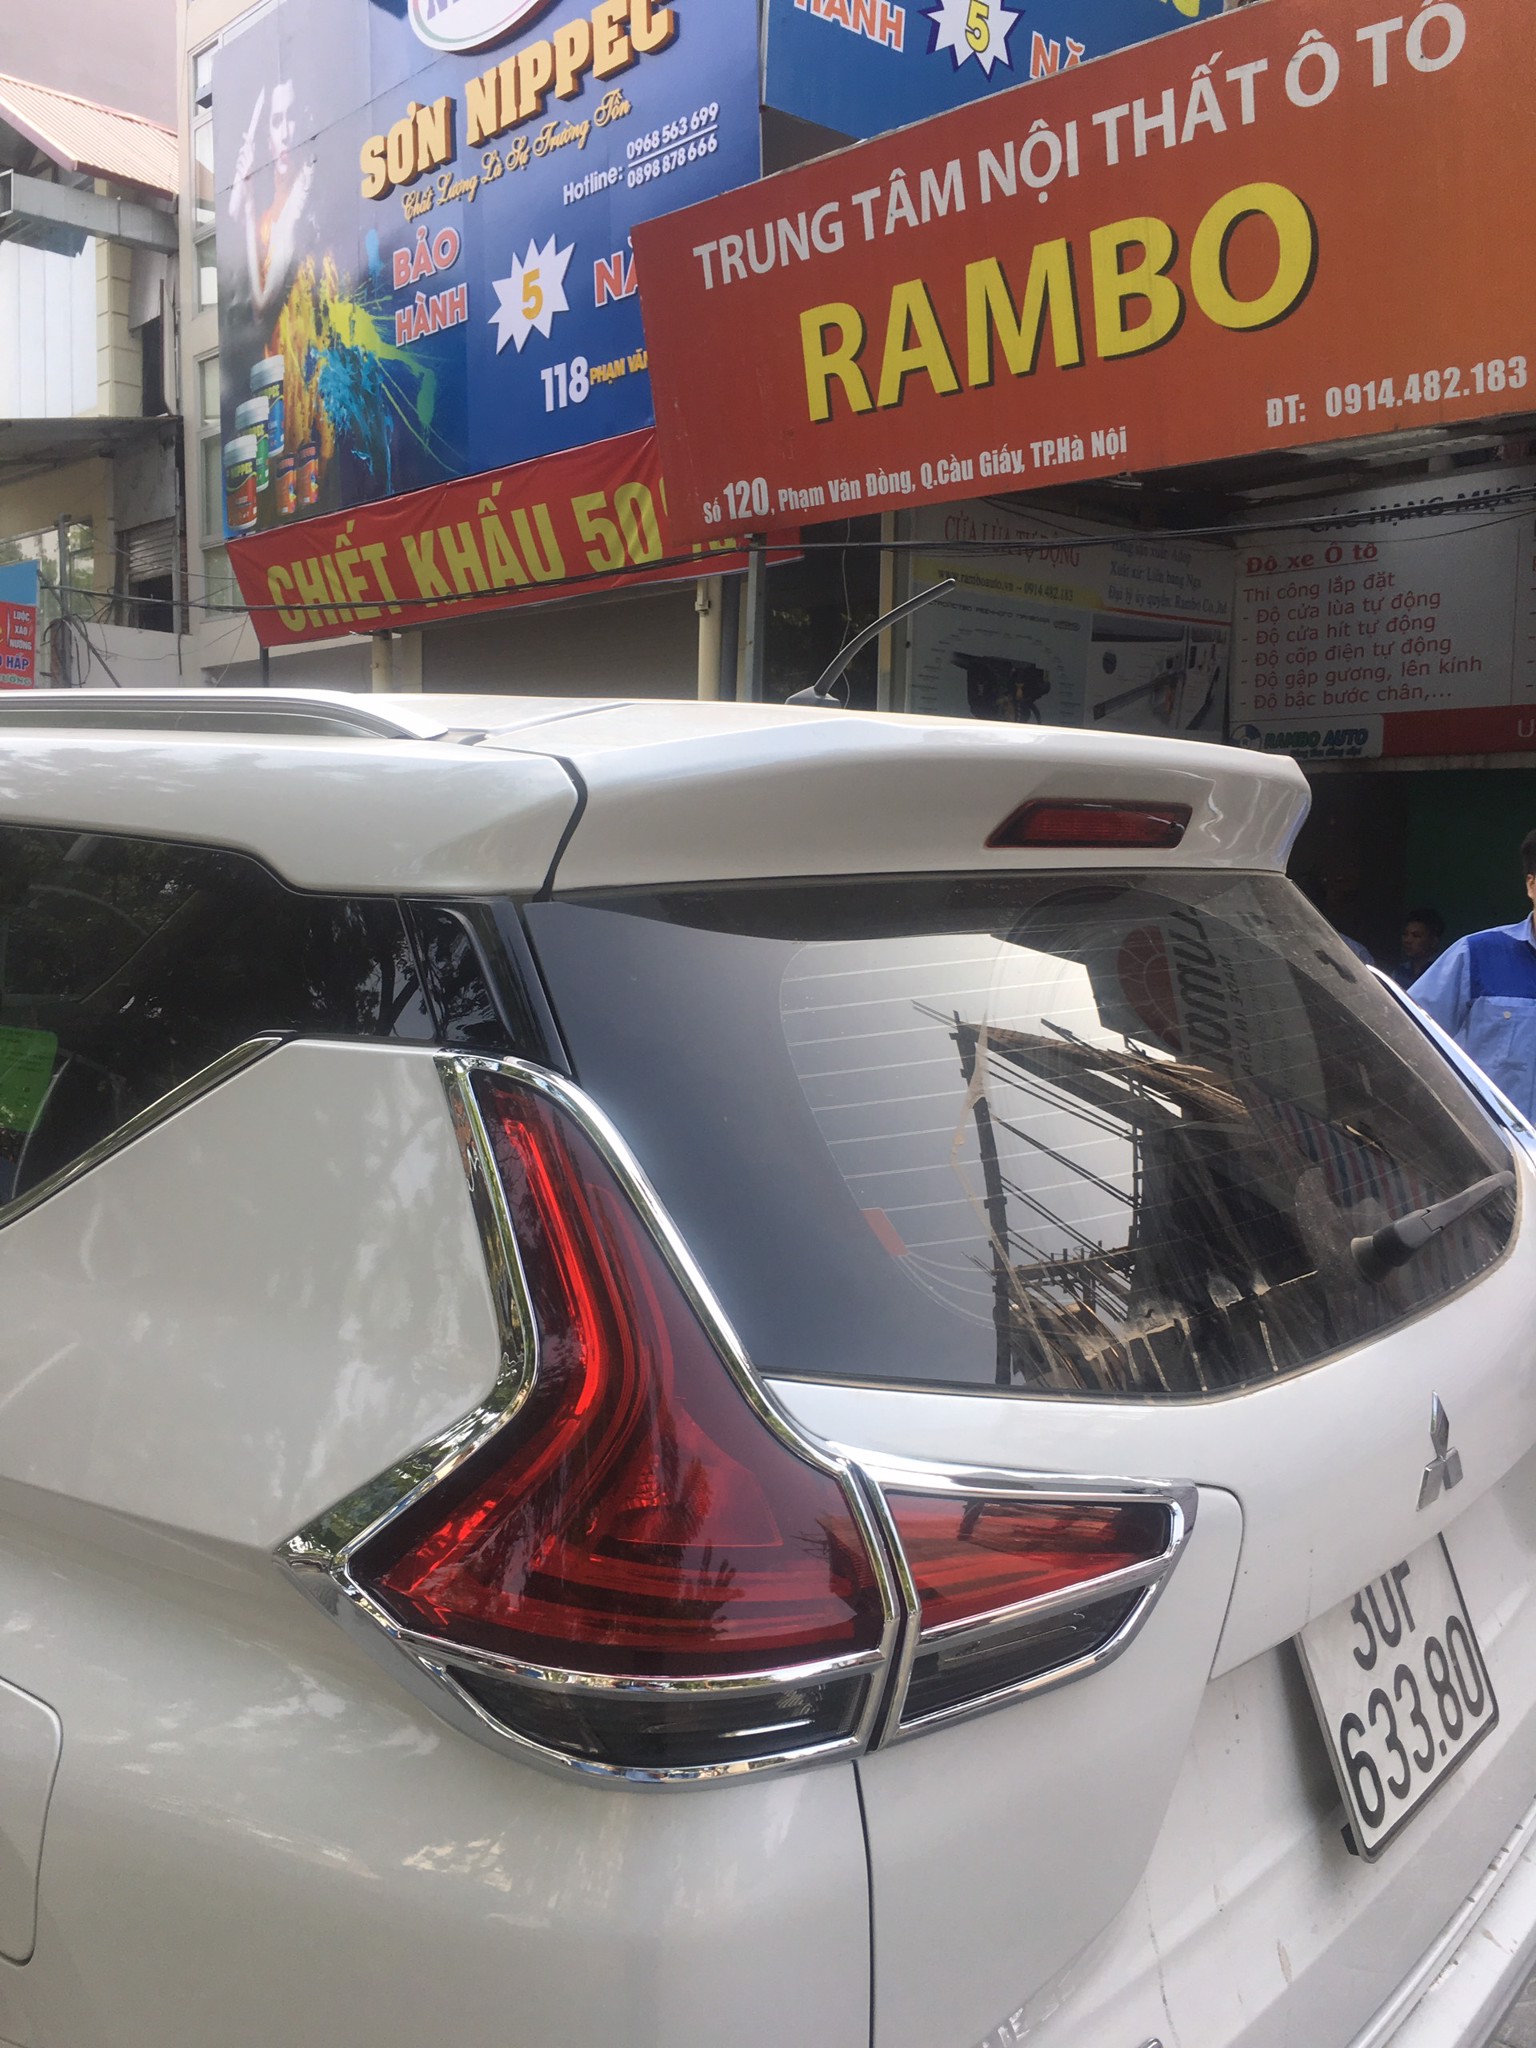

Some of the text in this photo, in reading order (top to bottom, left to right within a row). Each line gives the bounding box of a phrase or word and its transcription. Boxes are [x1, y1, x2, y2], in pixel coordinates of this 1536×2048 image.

[965, 0, 990, 53] 5
[360, 0, 675, 199] SƠN NIPPEC
[402, 88, 631, 222] Chất Lượng Là Sự Trường Tồn
[627, 102, 718, 159] 0968 563 699
[563, 166, 623, 205] Hotline:
[627, 133, 717, 188] 0898 878 666
[692, 202, 844, 290] TRUNG
[851, 167, 966, 242] TÂM
[977, 118, 1079, 204] NỘI
[1092, 50, 1268, 166] THẤT
[1284, 28, 1340, 108] Ô
[393, 225, 459, 290] BẢO
[395, 283, 468, 347] HÀNH
[522, 268, 543, 320] 5
[799, 181, 1316, 423] RAMBO
[541, 356, 589, 412] 118
[590, 358, 625, 385] PHẠM
[1267, 355, 1527, 428] ĐT: 0914.482.183
[703, 496, 722, 524] Số
[778, 483, 825, 513] Phạm
[828, 476, 861, 503] Văn
[865, 467, 916, 497] Đồng,
[920, 454, 974, 490] Q.Cầu
[979, 443, 1025, 478] Giấy,
[1030, 434, 1085, 468] TP.Hà
[1090, 425, 1127, 458] Nội
[267, 520, 402, 632] CHIẾT
[400, 481, 567, 608] KHẤU
[1246, 541, 1378, 575] Độ xe Ô tô
[1243, 571, 1396, 603] Thi công lắp đặt
[1256, 591, 1441, 626] Độ cửa lùa tự động
[1255, 636, 1451, 668] Độ cốp điện tự động
[1256, 614, 1436, 646] Độ cửa hít tự động
[1254, 693, 1278, 710] Độ
[1284, 691, 1317, 711] bậc
[1323, 687, 1369, 704] bước
[1255, 656, 1482, 689] Độ gập gương, lên kính
[1340, 1615, 1484, 1828] 633.80
